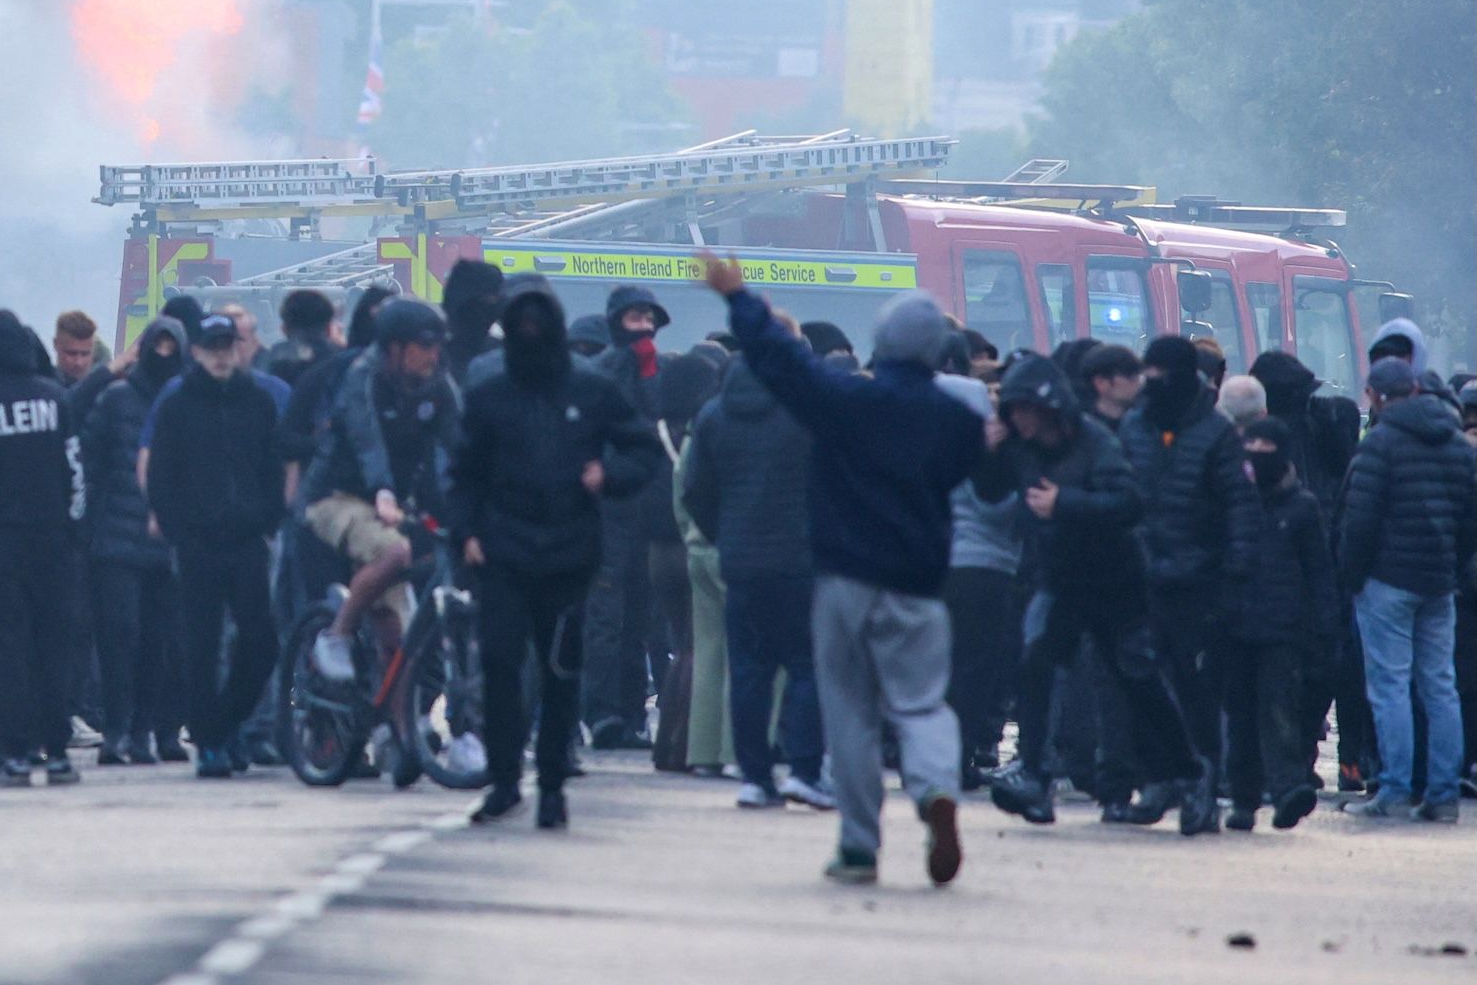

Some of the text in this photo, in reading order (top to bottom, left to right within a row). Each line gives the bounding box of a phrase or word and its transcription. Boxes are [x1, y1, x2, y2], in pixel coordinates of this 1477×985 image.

[572, 255, 626, 275] Northern
[631, 257, 672, 277] Ireland
[677, 259, 700, 278] Fire
[770, 264, 816, 282] Service
